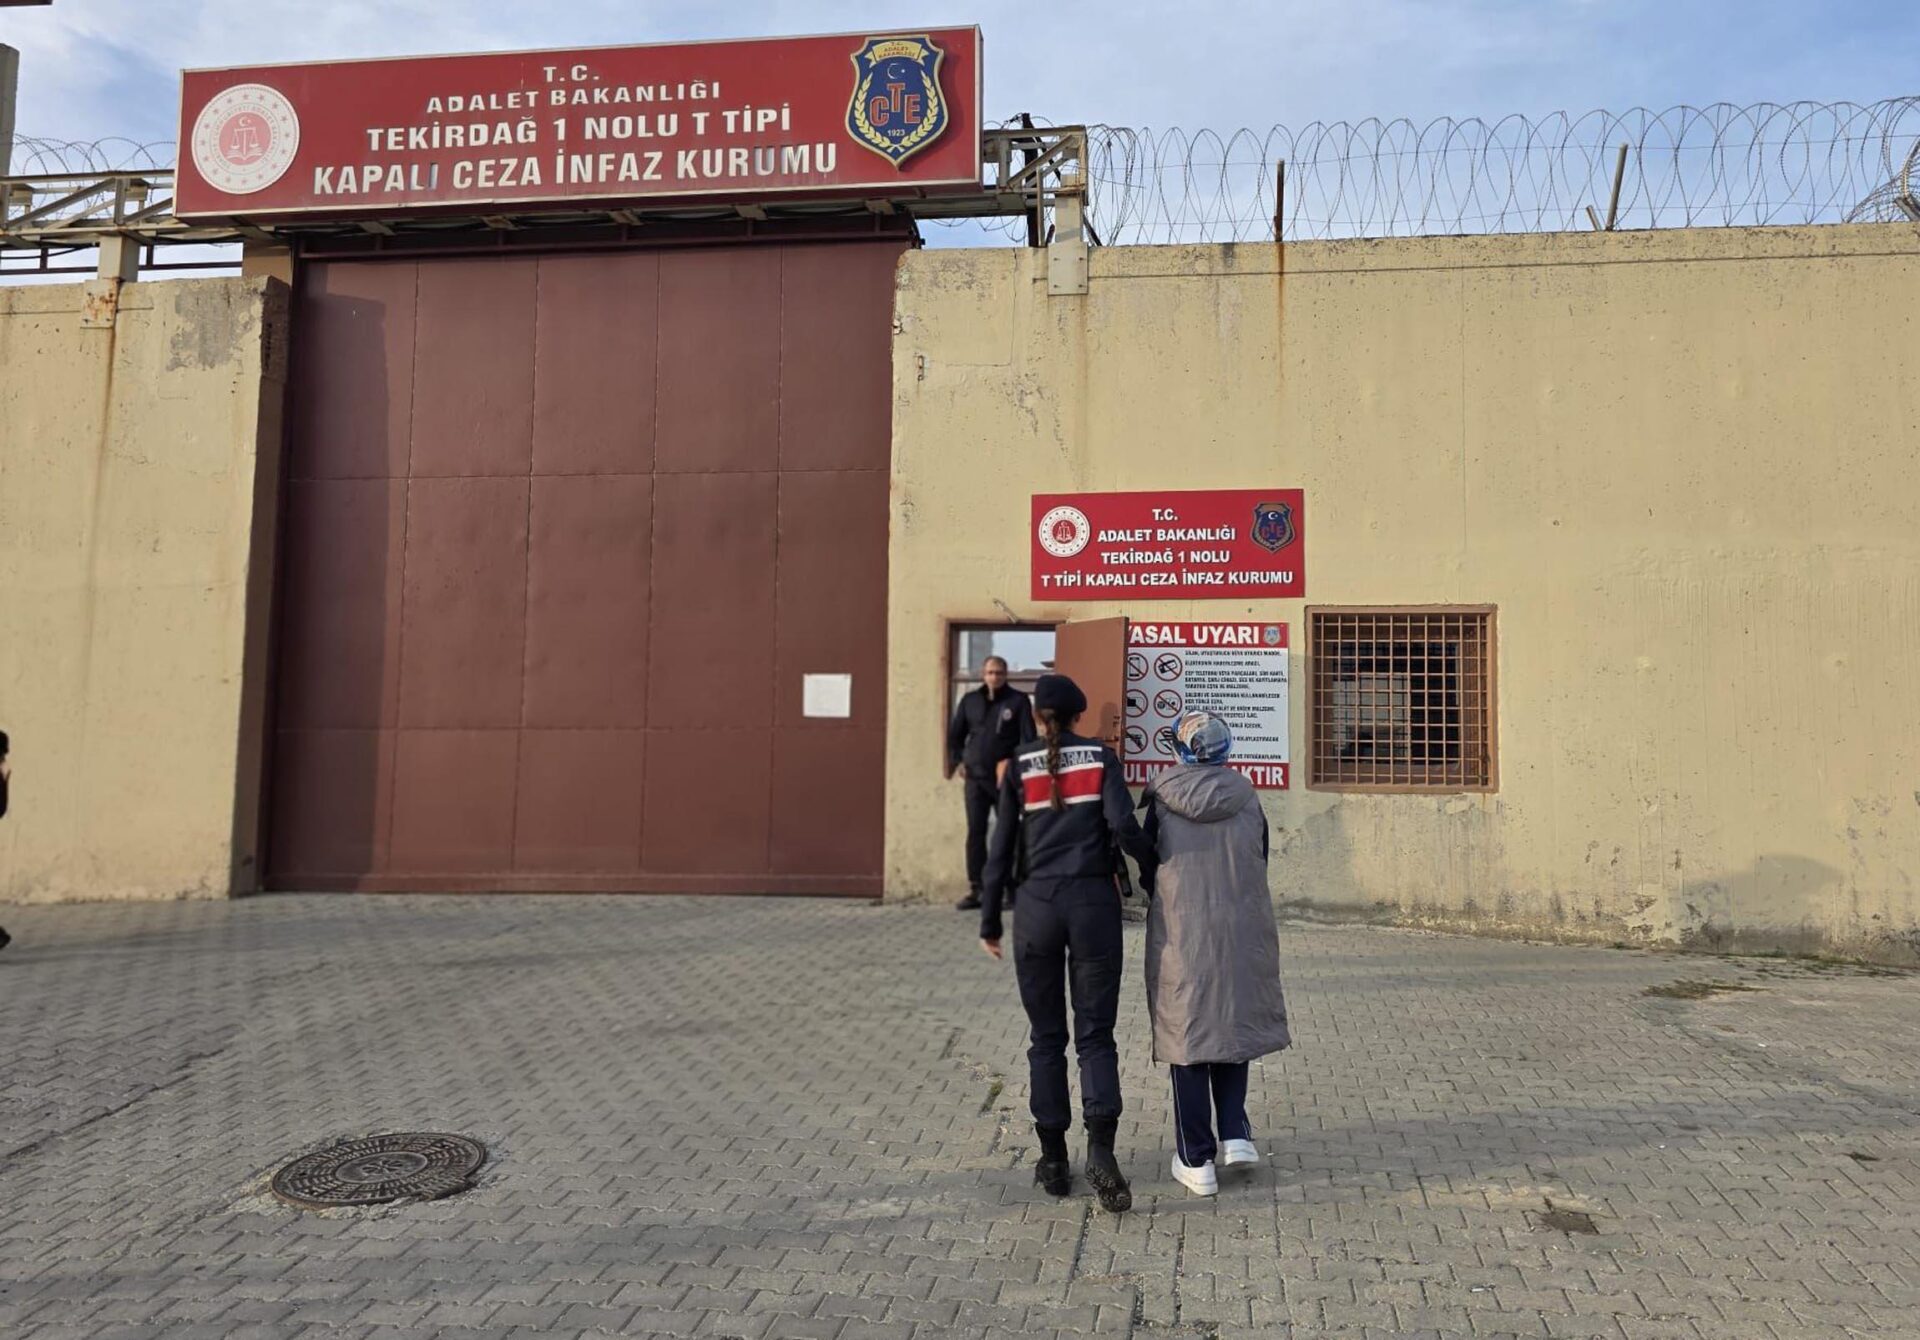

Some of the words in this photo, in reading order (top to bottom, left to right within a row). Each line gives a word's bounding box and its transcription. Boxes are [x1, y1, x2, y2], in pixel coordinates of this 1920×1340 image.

[543, 64, 600, 83] T.C.
[426, 91, 540, 114] ADALET
[550, 80, 721, 106] BAKANLIĞI
[870, 82, 921, 126] CTE
[366, 115, 538, 151] TEKİRDAĞ
[553, 117, 567, 142] 1
[584, 113, 678, 141] NOLU
[692, 112, 710, 136] T
[722, 103, 791, 134] TİPİ
[313, 162, 439, 195] KAPALI
[452, 156, 542, 190] CEZA
[555, 148, 663, 185] İNFAZ
[676, 142, 837, 180] KURUMU
[1152, 508, 1178, 521] T.C.
[1097, 529, 1153, 542] ADALET
[1156, 524, 1236, 541] BAKANLIĞI
[1101, 548, 1174, 564] TEKİRDAĞ
[1178, 551, 1185, 563] 1
[1190, 550, 1231, 563] NOLU
[1041, 575, 1051, 587] T
[1054, 570, 1081, 587] TİPİ
[1085, 573, 1136, 586] KAPALI
[1140, 572, 1178, 586] CEZA
[1182, 568, 1224, 585] İNFAZ
[1228, 571, 1293, 584] KURUMU
[1128, 625, 1187, 644] ASAL
[1193, 625, 1259, 644] UYARI
